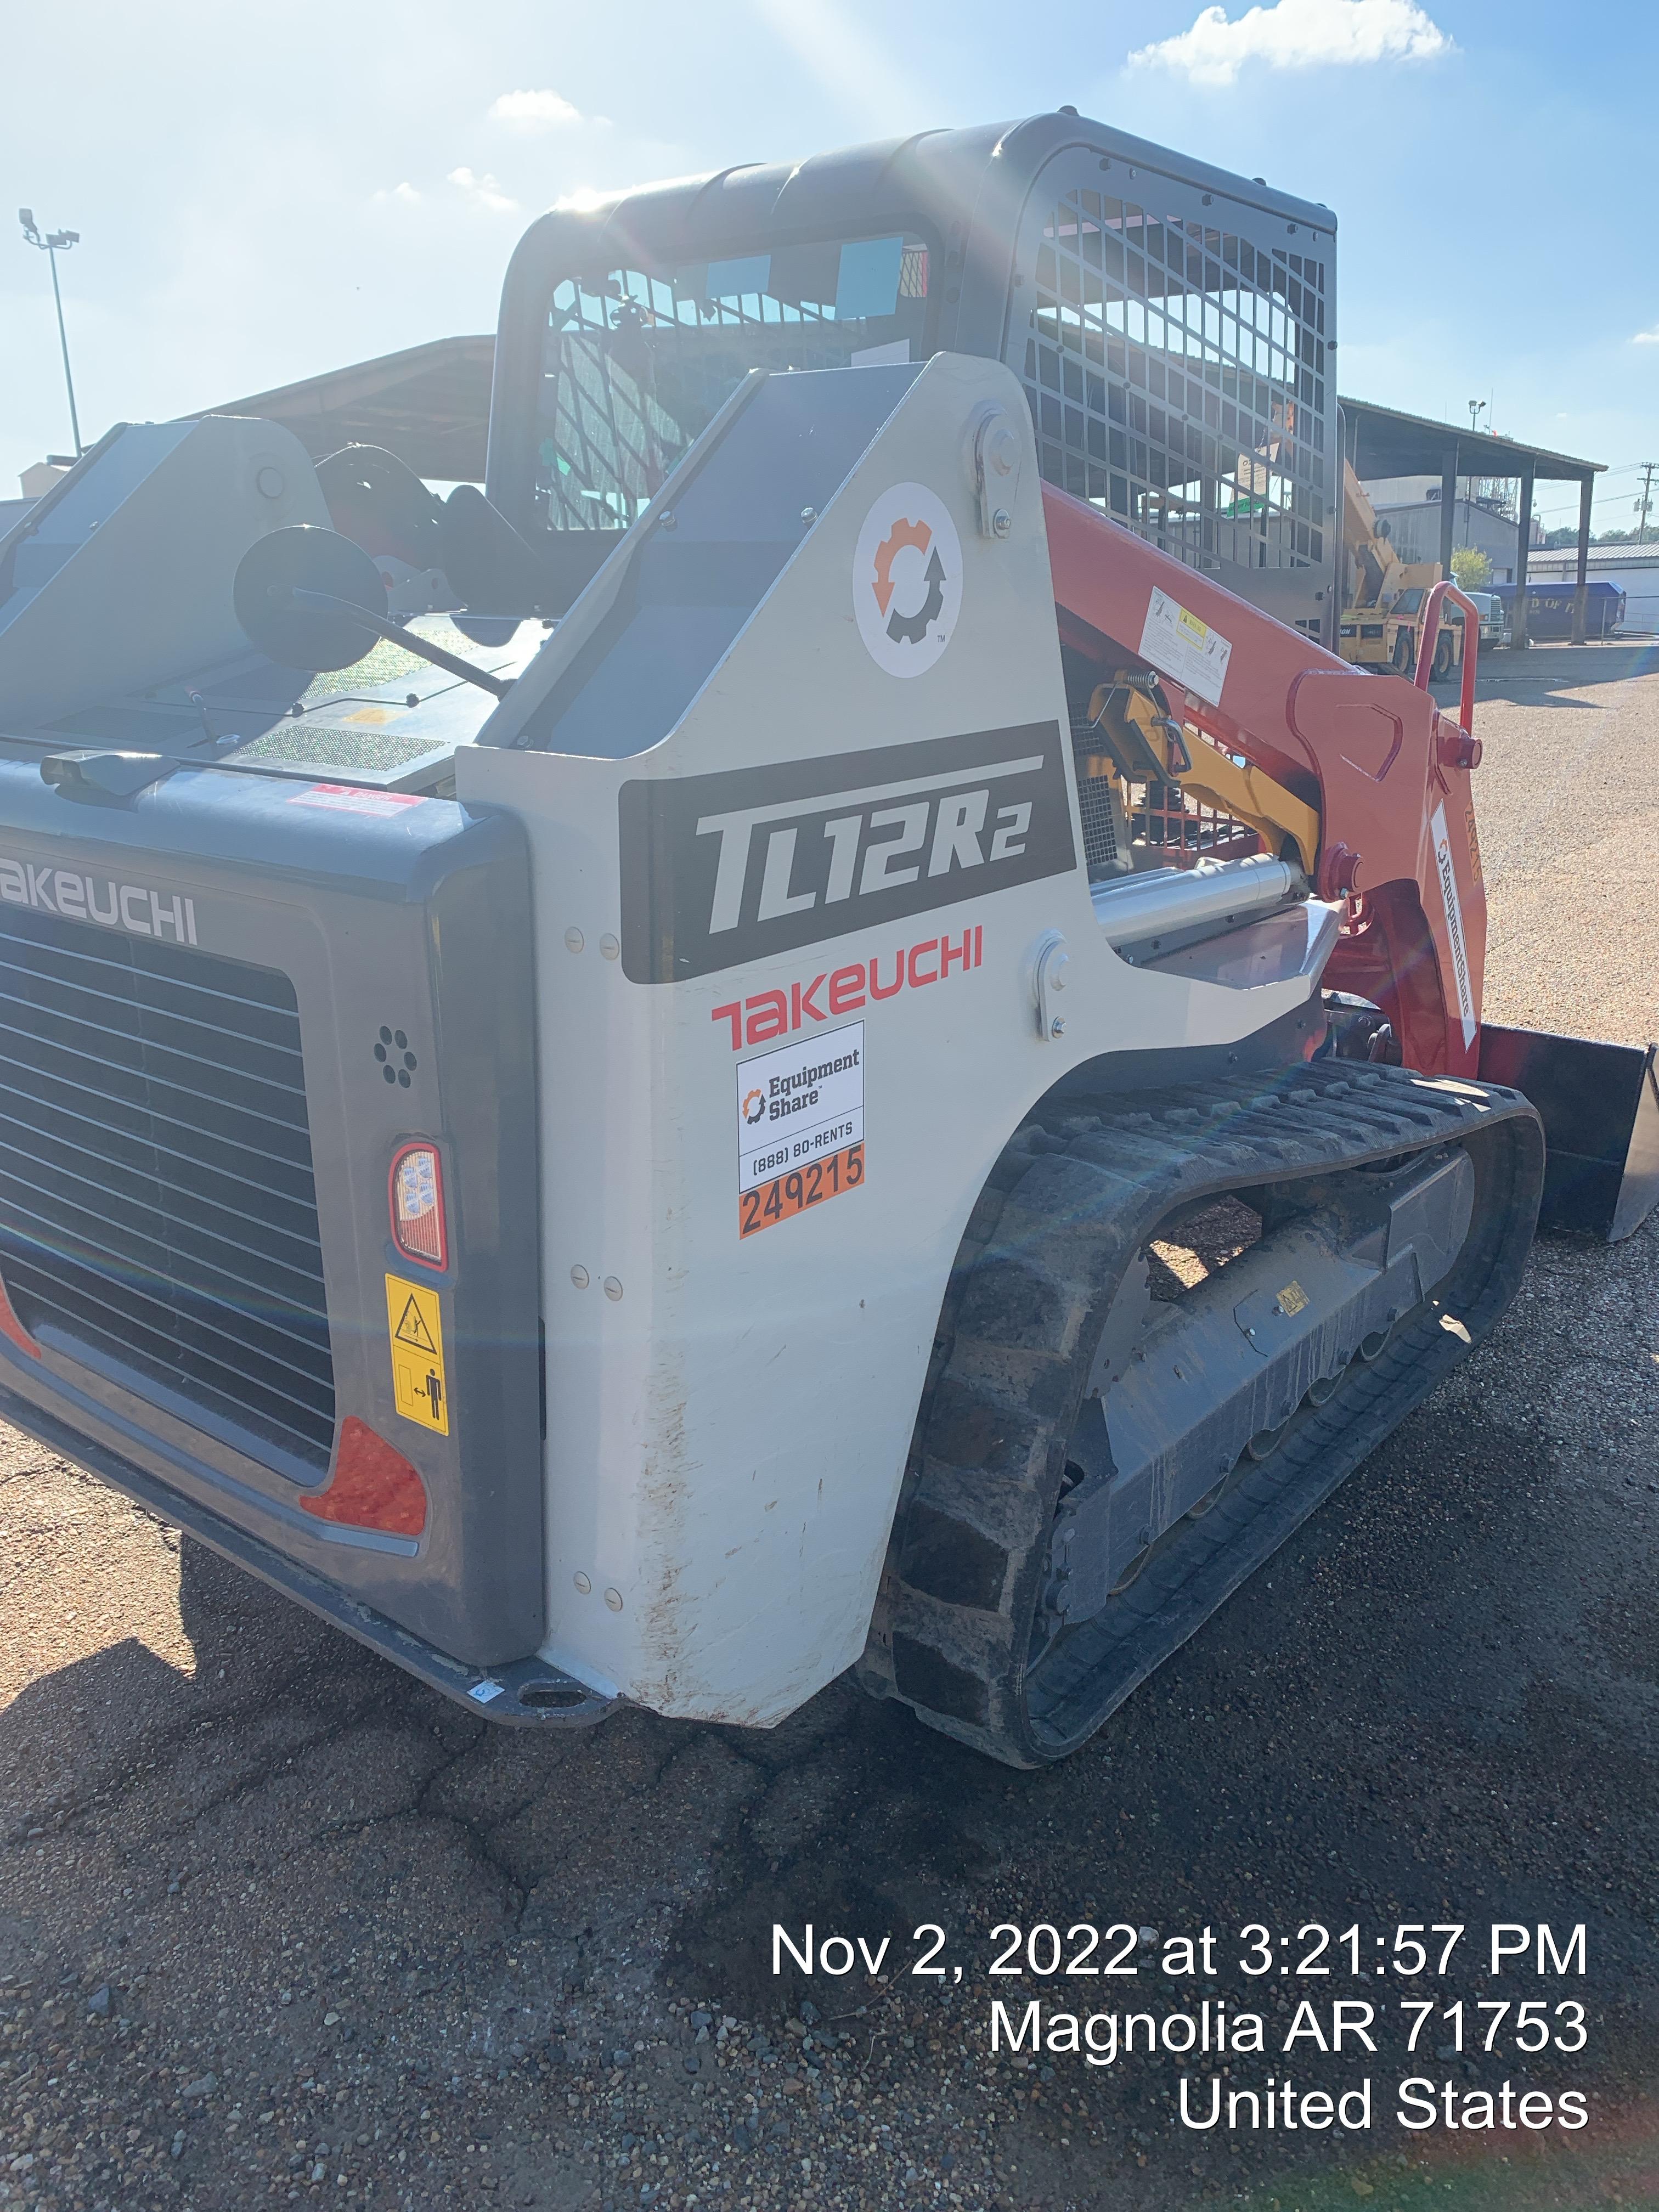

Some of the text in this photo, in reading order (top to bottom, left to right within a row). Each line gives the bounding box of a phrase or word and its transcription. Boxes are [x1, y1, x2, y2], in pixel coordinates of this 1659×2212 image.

[0, 857, 198, 946] AKEUCHI
[1441, 859, 1469, 1017] EquipmentShare
[769, 1049, 860, 1097] Equipment
[769, 1090, 819, 1121] Share
[753, 1121, 853, 1176] (888) 80-RENTS
[742, 1144, 862, 1234] 249215
